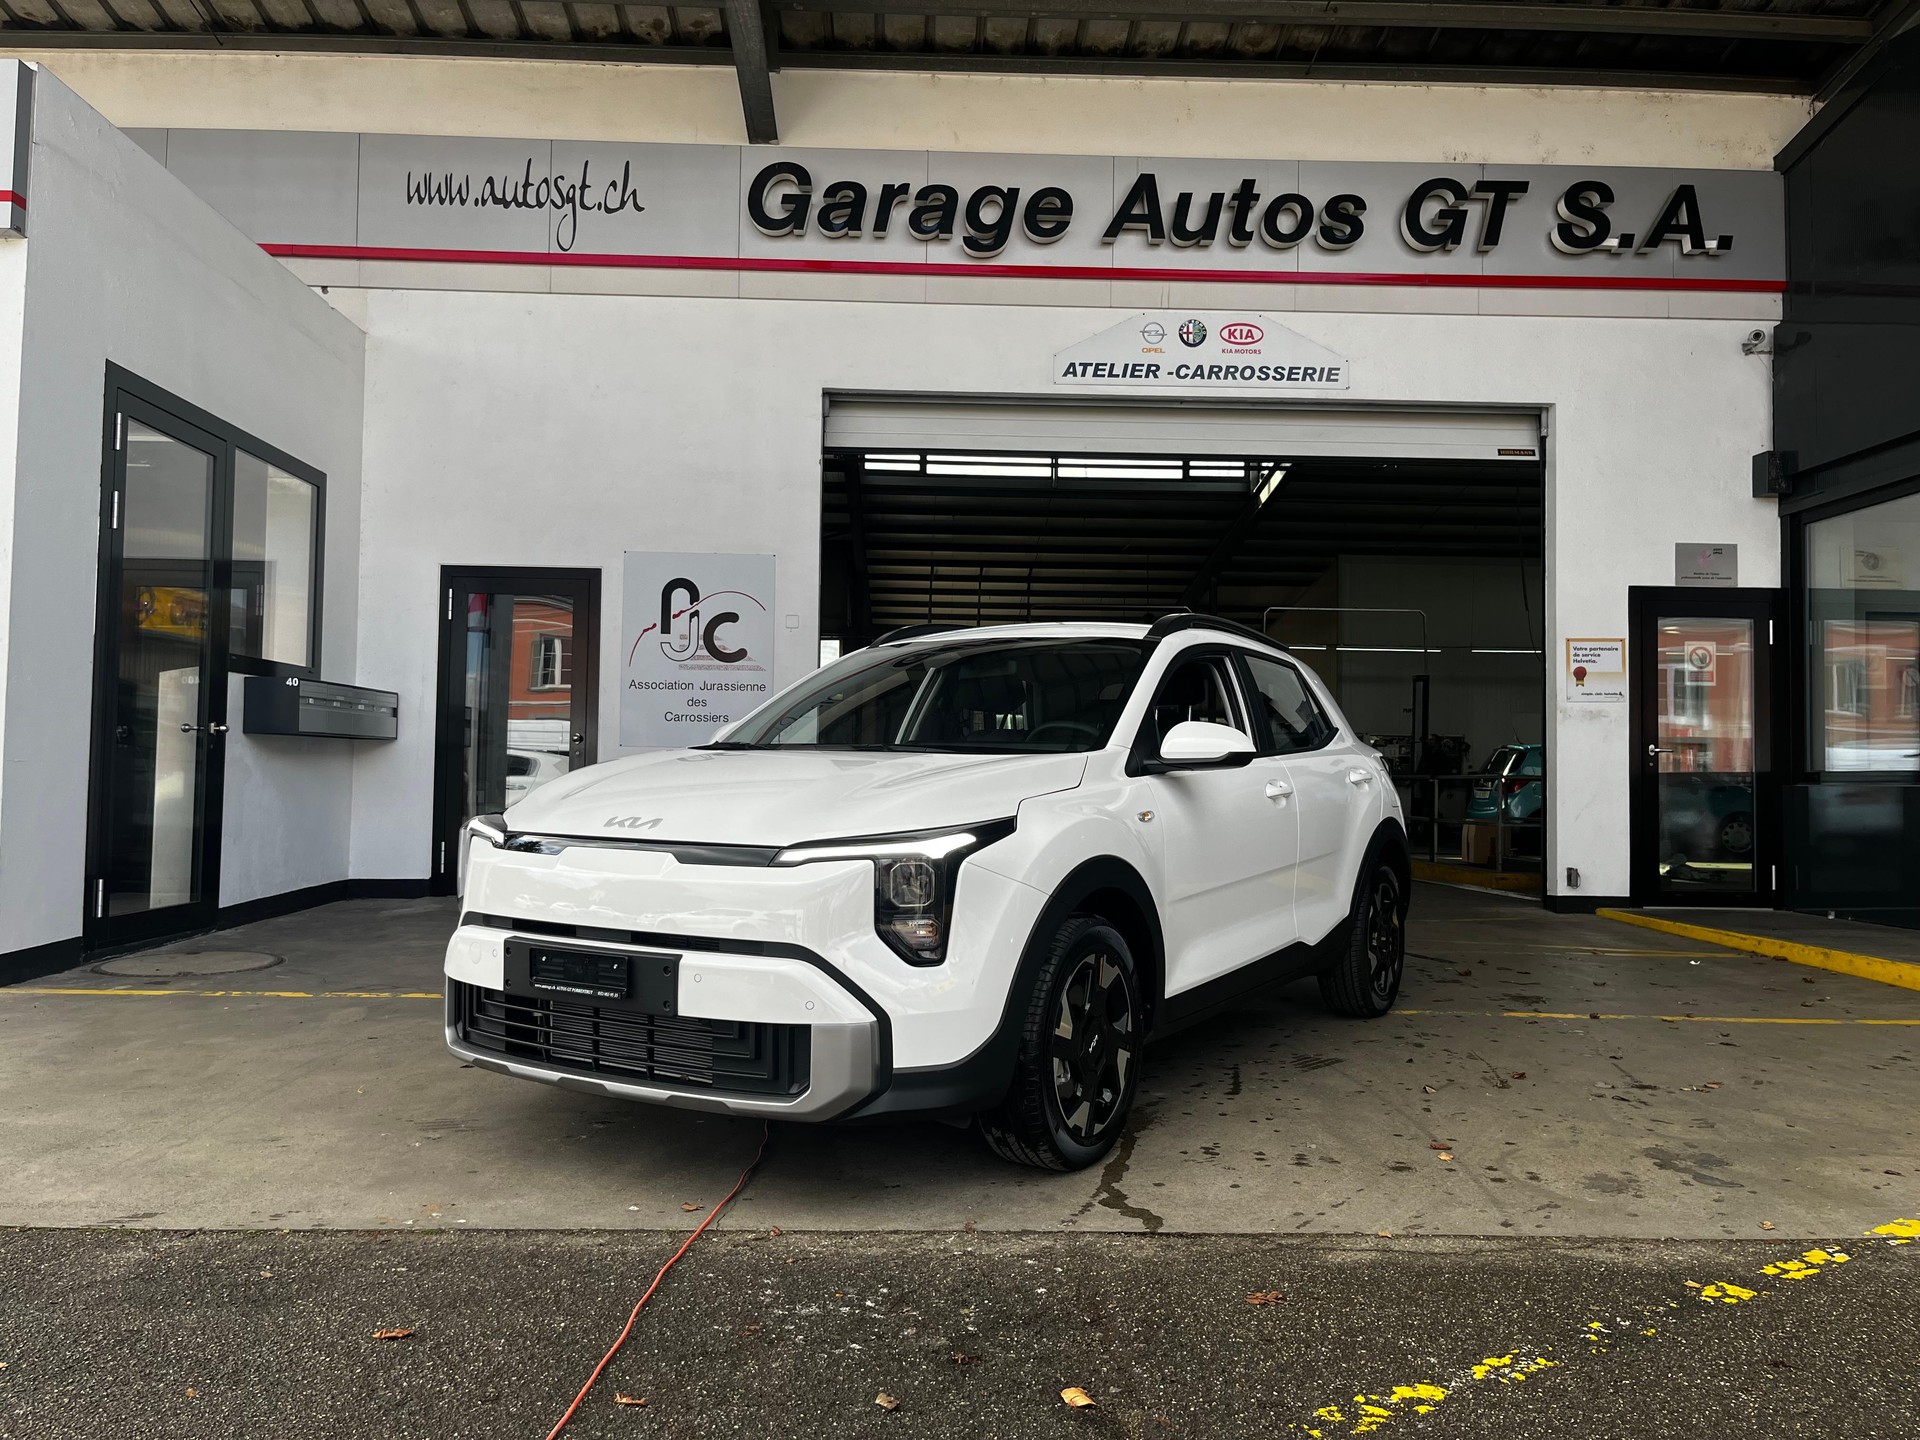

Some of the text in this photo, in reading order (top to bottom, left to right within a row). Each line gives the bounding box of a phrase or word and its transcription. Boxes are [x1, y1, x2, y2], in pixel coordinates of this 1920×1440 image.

[406, 157, 646, 252] www.autosgt.ch
[747, 161, 1734, 258] Garage Autos GT S.A.
[1227, 328, 1256, 341] KIA
[1062, 362, 1161, 379] ATELIER
[1588, 645, 1619, 653] partenaire
[285, 677, 299, 687] 40
[628, 679, 767, 693] Association Jurassienne
[686, 696, 708, 708] des
[664, 711, 730, 724] Carrossiers
